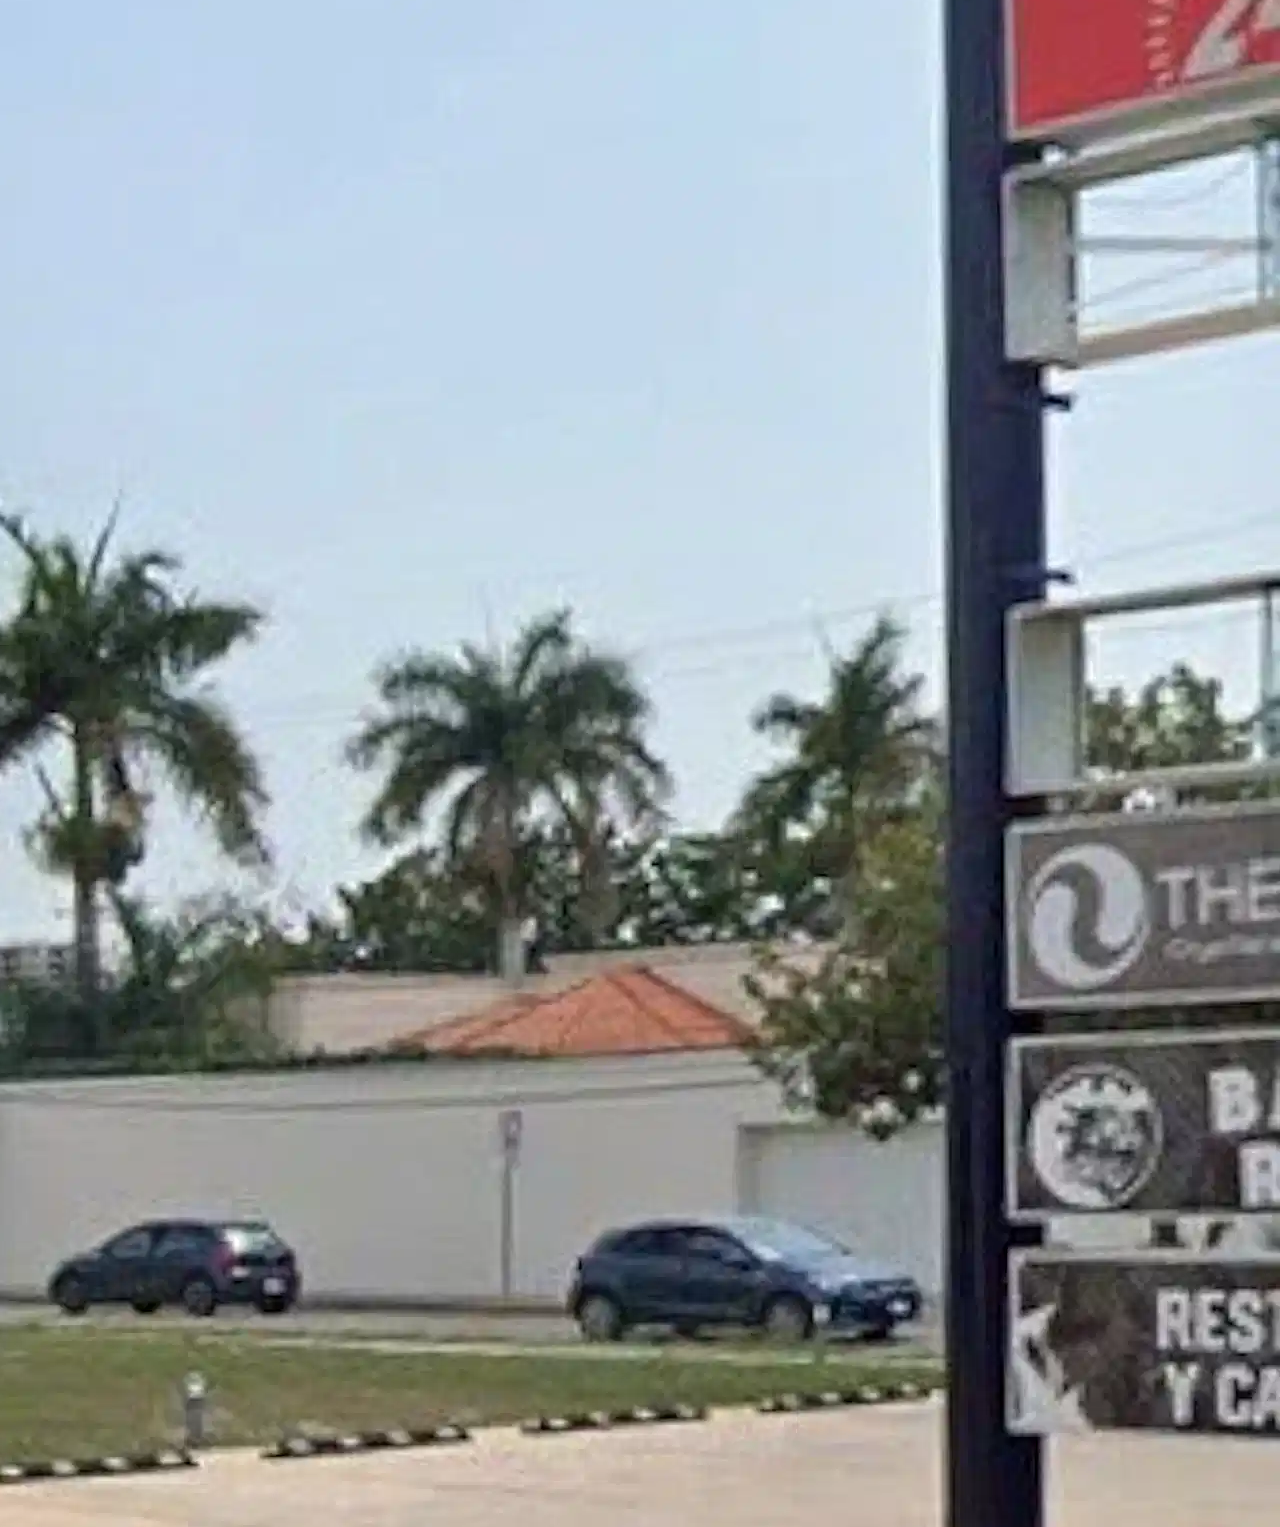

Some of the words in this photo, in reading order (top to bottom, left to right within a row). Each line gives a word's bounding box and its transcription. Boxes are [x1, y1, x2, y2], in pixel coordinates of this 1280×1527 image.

[1154, 857, 1280, 930] THE
[1208, 1066, 1280, 1133] B
[1163, 1361, 1200, 1426] Y
